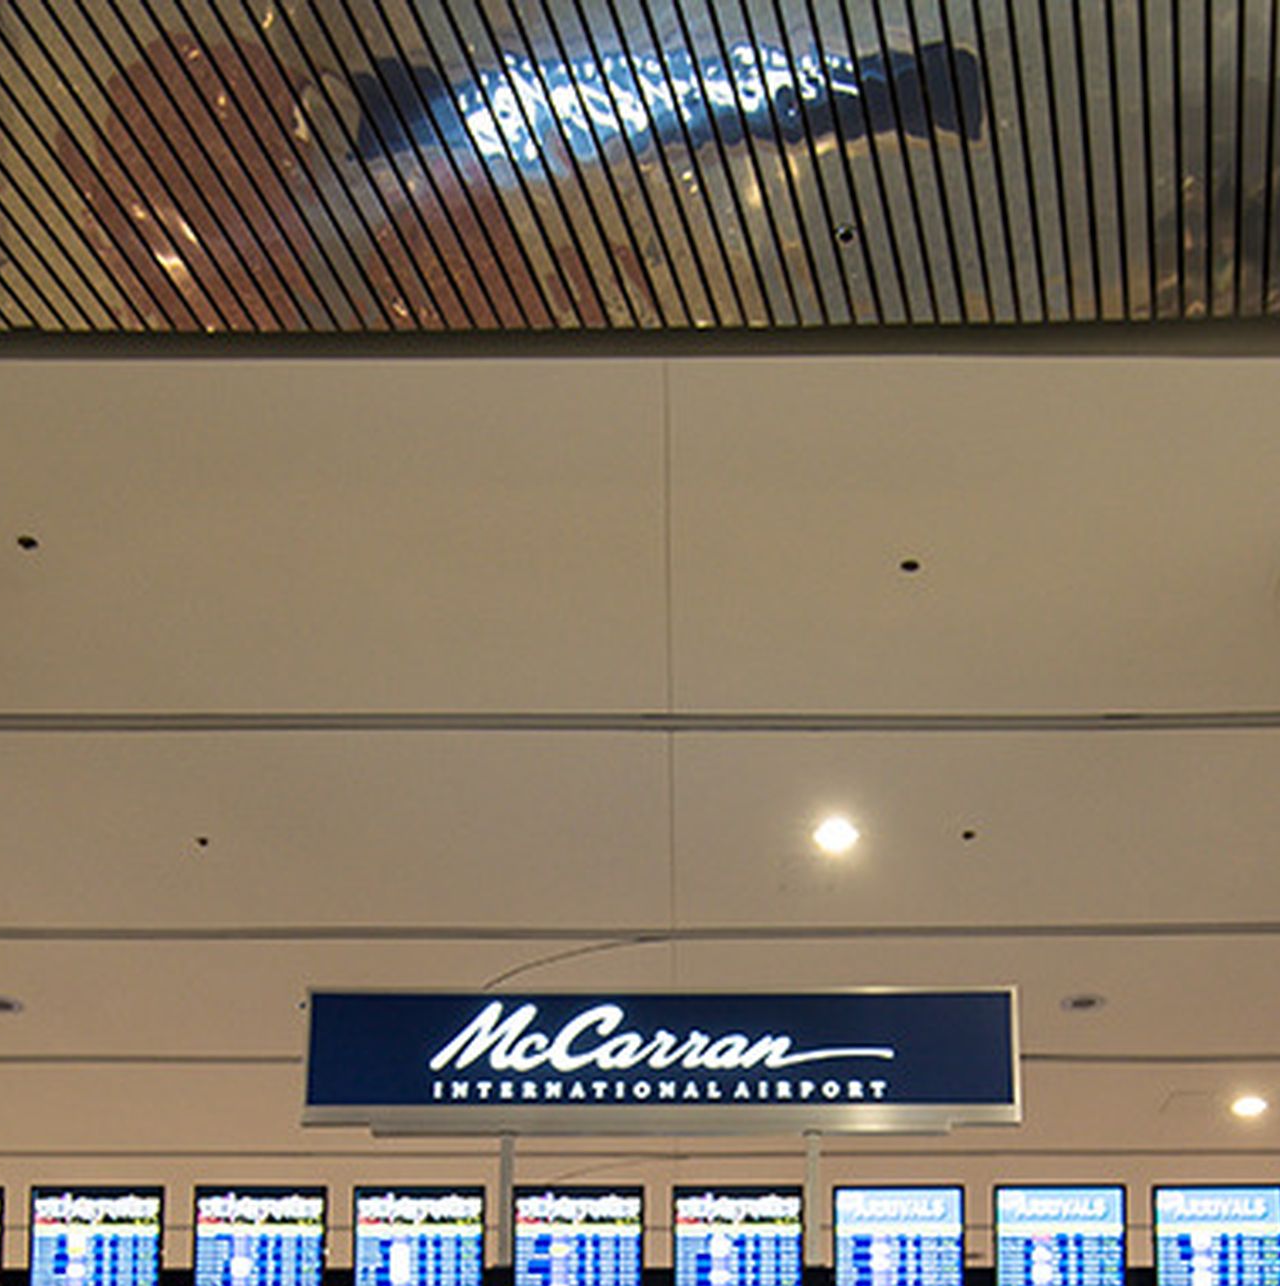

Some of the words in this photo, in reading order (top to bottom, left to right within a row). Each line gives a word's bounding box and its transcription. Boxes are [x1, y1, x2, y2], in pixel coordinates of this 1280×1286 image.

[430, 1001, 894, 1072] McCarran
[433, 1080, 721, 1099] INTERNATIONAL
[733, 1080, 887, 1099] AIRPORT
